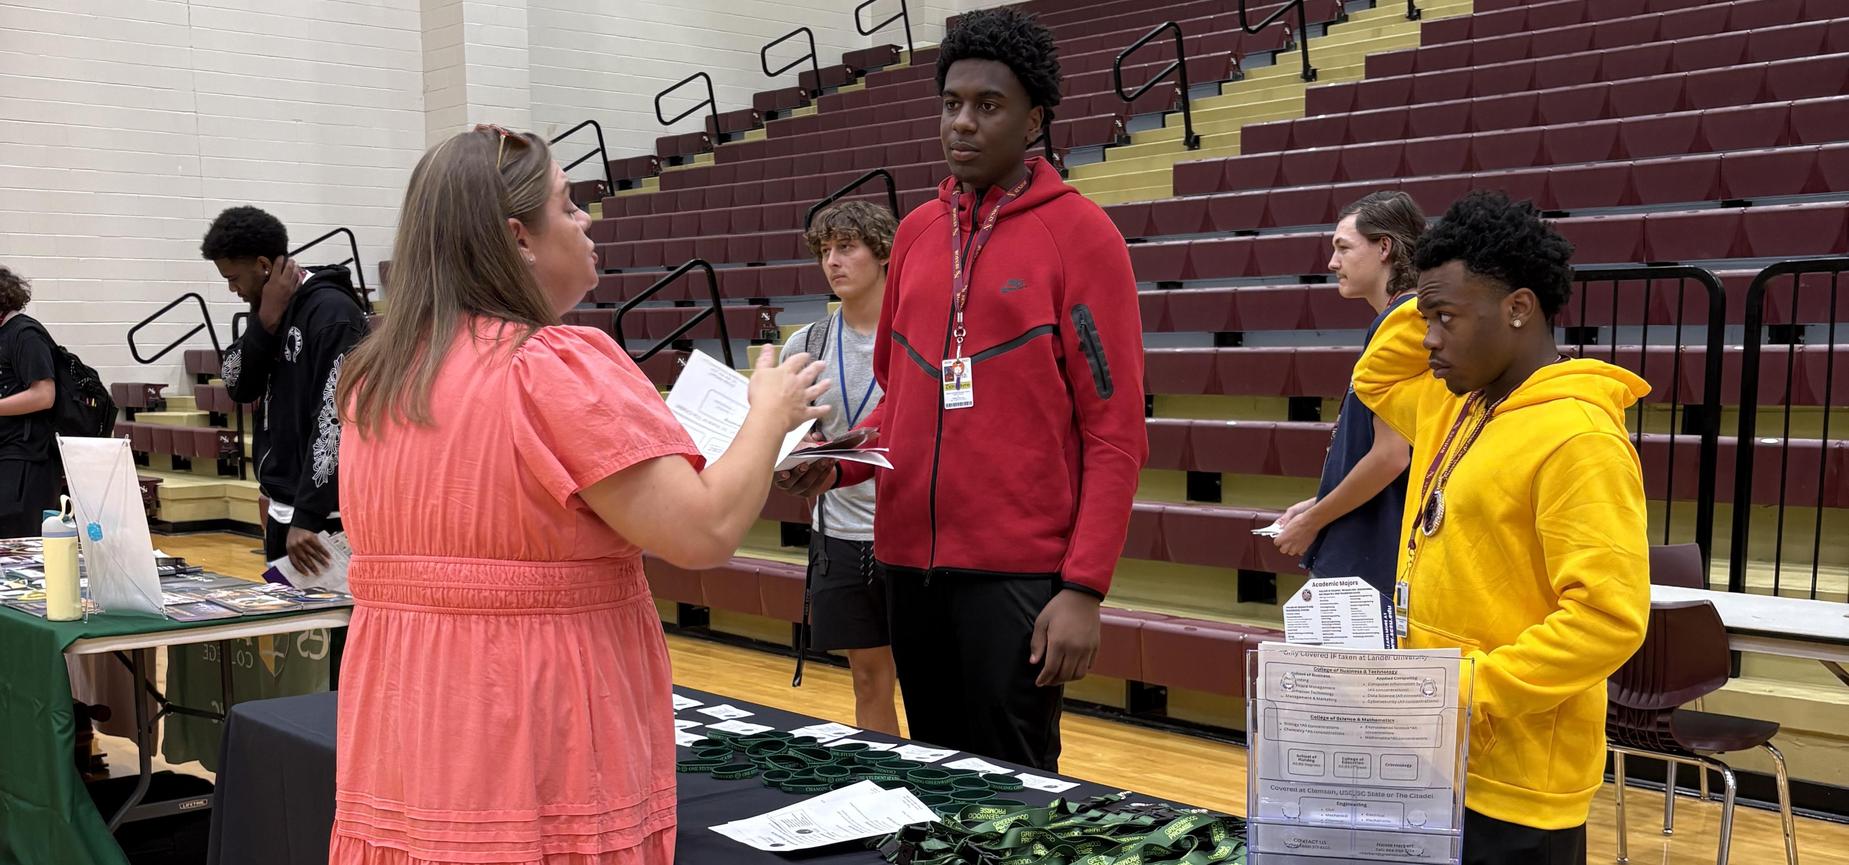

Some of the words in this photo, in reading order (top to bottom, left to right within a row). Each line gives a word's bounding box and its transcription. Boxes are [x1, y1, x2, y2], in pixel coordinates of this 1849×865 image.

[1300, 651, 1329, 659] Covered
[1338, 653, 1358, 661] taken
[1313, 666, 1334, 674] College
[1270, 784, 1298, 792] Covered
[1307, 787, 1338, 796] Clemson,
[980, 807, 1007, 815] PROMISE
